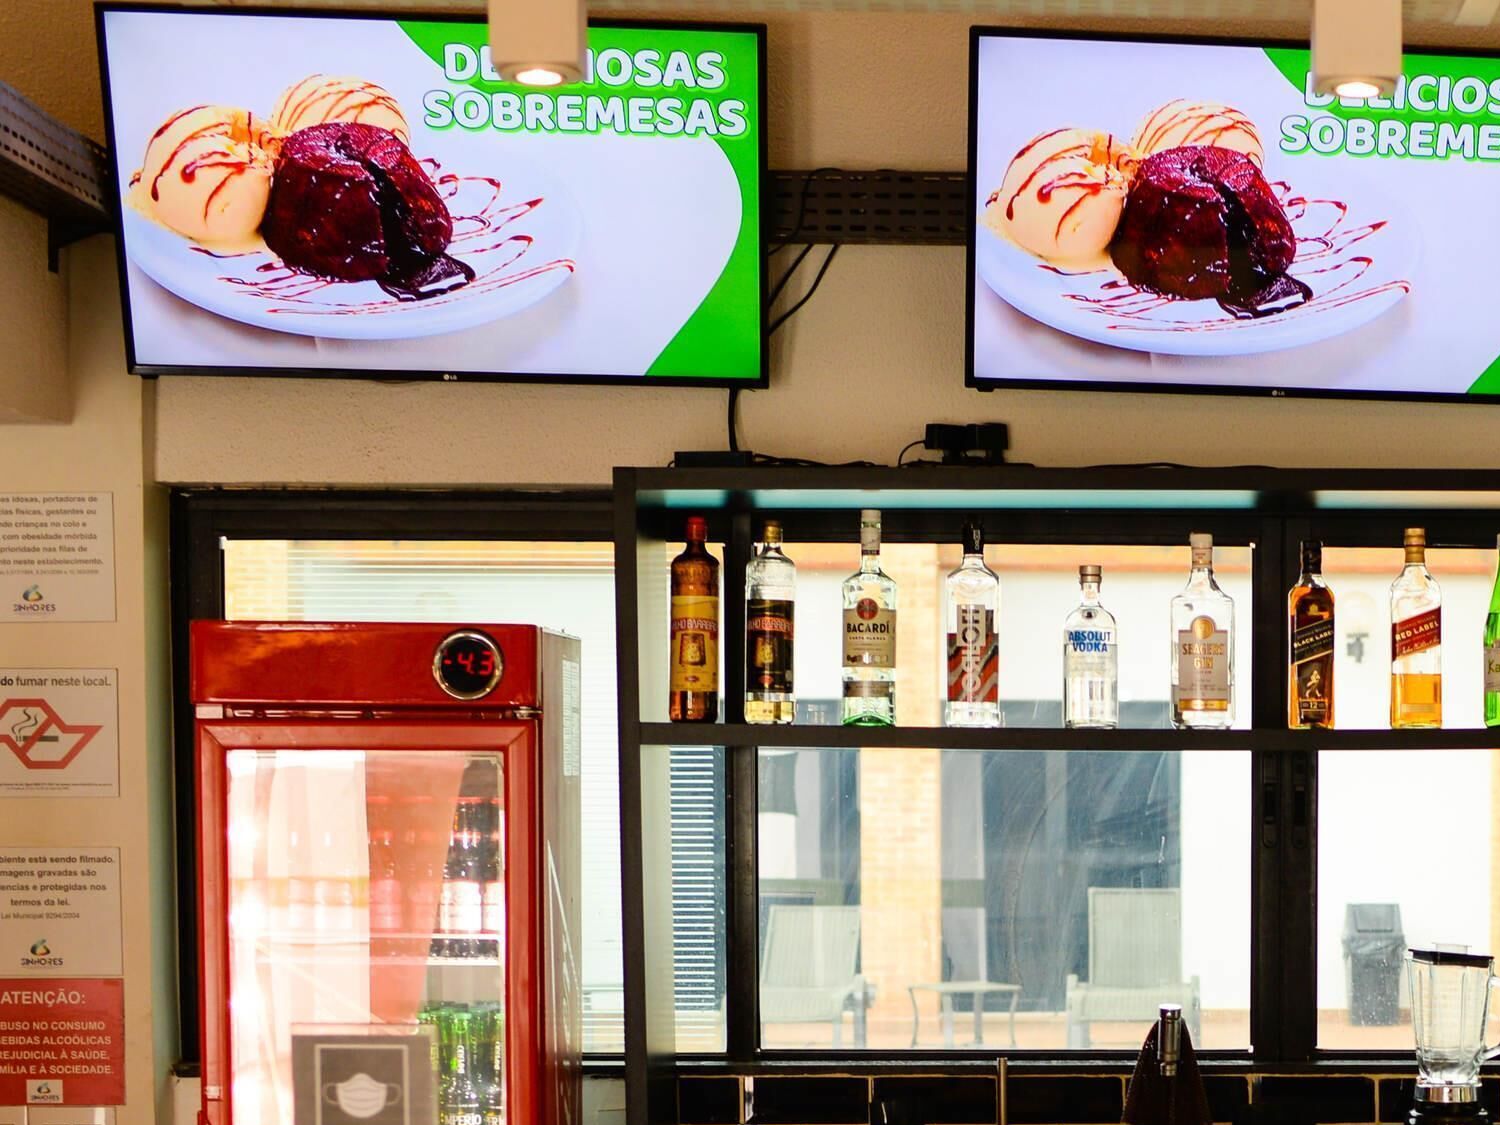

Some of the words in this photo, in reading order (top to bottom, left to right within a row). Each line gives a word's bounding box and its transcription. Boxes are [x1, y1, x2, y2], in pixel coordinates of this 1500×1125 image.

[443, 43, 726, 89] DEIOSAS
[423, 90, 748, 136] SOBREMESAS
[847, 621, 890, 633] BACARDÍ
[1395, 630, 1413, 641] RED
[1413, 620, 1439, 634] LABEL
[1068, 631, 1110, 641] ABSOLUT
[1073, 642, 1107, 652] VODKA
[1194, 656, 1214, 669] GIN
[16, 676, 47, 686] fumar
[51, 676, 80, 686] neste
[83, 675, 111, 686] local.
[28, 855, 47, 864] está
[49, 855, 77, 864] sendo
[80, 855, 115, 864] filmado.
[37, 869, 78, 878] gravadas
[81, 869, 97, 877] são
[40, 883, 87, 892] protegidas
[44, 898, 55, 906] da
[0, 988, 86, 1008] ATENÇÃO:
[32, 1021, 48, 1031] NO
[50, 1021, 106, 1031] CONSUMO
[29, 1065, 37, 1074] E
[49, 1064, 114, 1074] SOCIEDADE.
